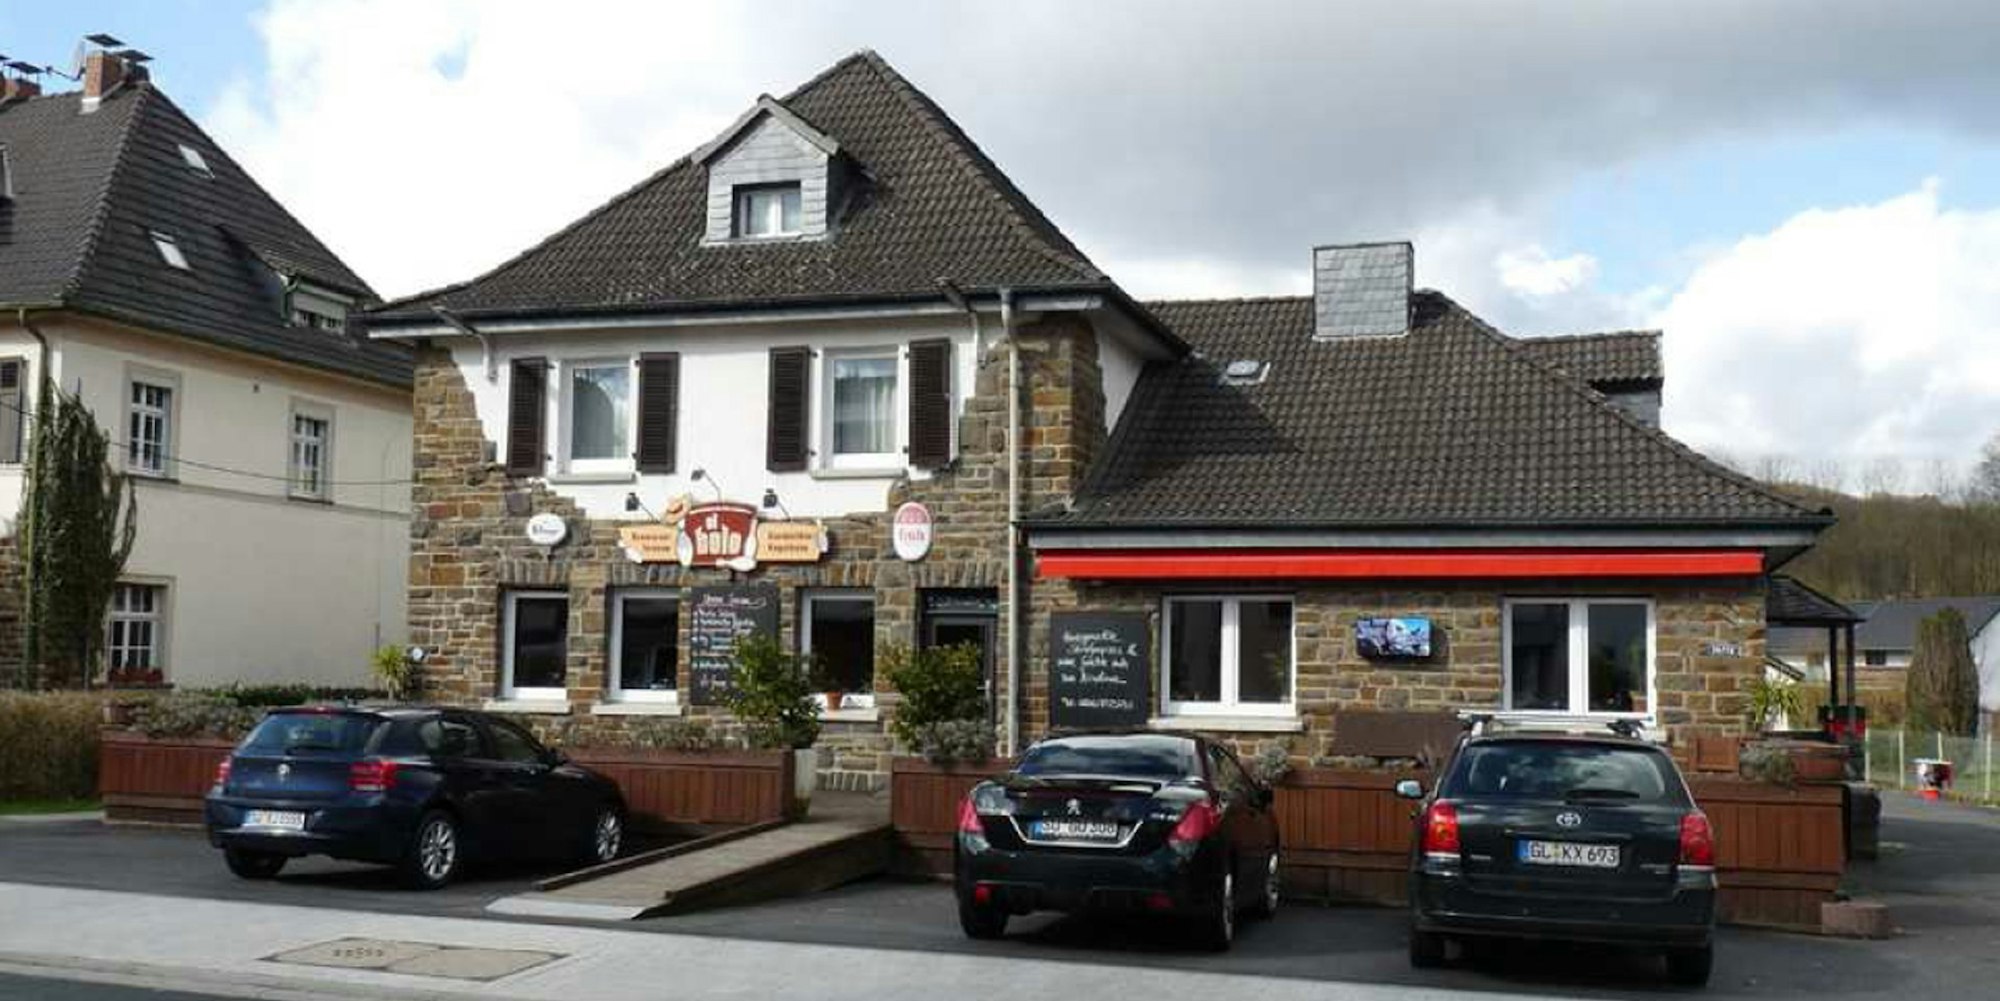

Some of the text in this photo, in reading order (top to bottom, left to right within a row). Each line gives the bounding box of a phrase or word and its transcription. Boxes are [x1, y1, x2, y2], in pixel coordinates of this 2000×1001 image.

[694, 524, 742, 555] bolo
[1531, 842, 1551, 859] GL
[1587, 847, 1616, 863] 693
